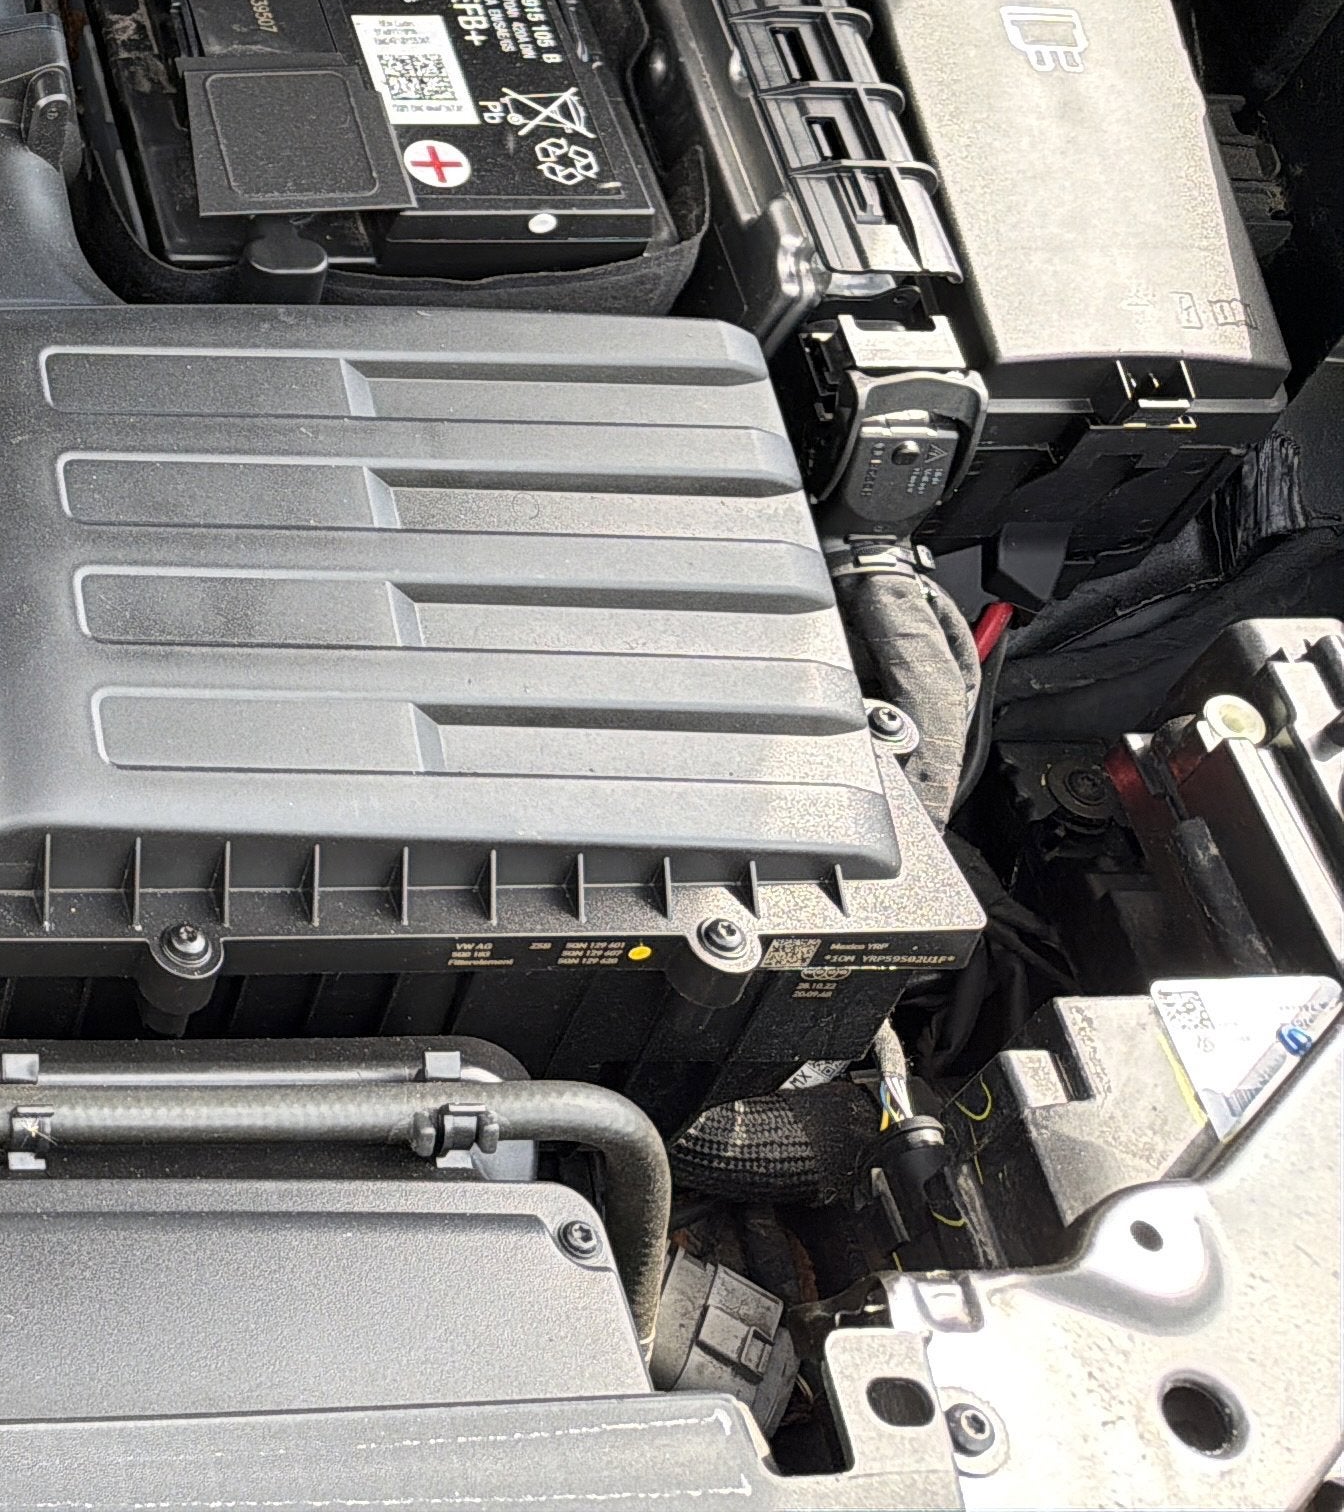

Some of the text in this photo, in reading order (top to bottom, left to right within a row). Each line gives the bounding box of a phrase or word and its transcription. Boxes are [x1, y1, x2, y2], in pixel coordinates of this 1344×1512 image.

[530, 23, 556, 48] 105
[541, 51, 564, 65] B
[477, 98, 505, 125] Pb
[789, 1069, 812, 1089] MX
